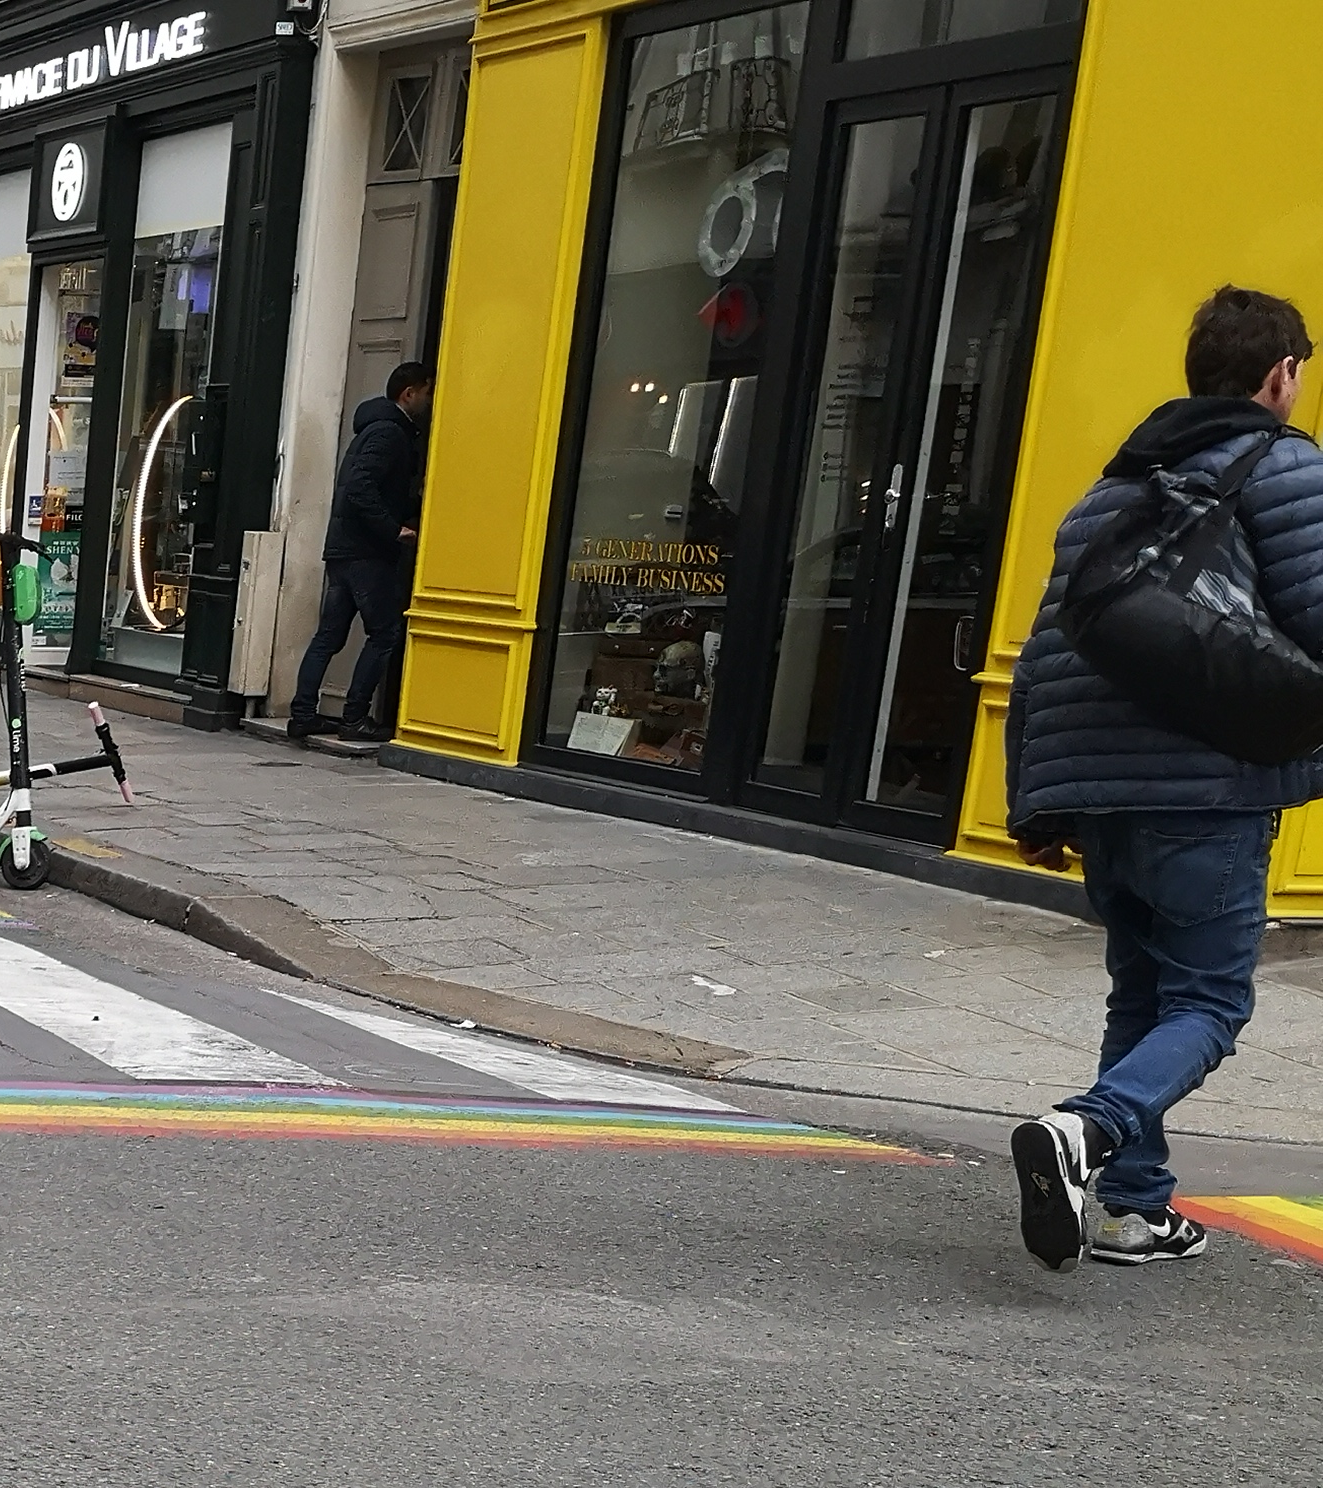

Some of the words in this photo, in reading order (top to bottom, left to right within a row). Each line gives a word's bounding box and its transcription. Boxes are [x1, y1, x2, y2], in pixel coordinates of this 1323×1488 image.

[66, 45, 101, 90] DU
[595, 539, 720, 567] GENERATIONS
[570, 562, 633, 587] FAMILY
[636, 567, 727, 595] BUSINESS
